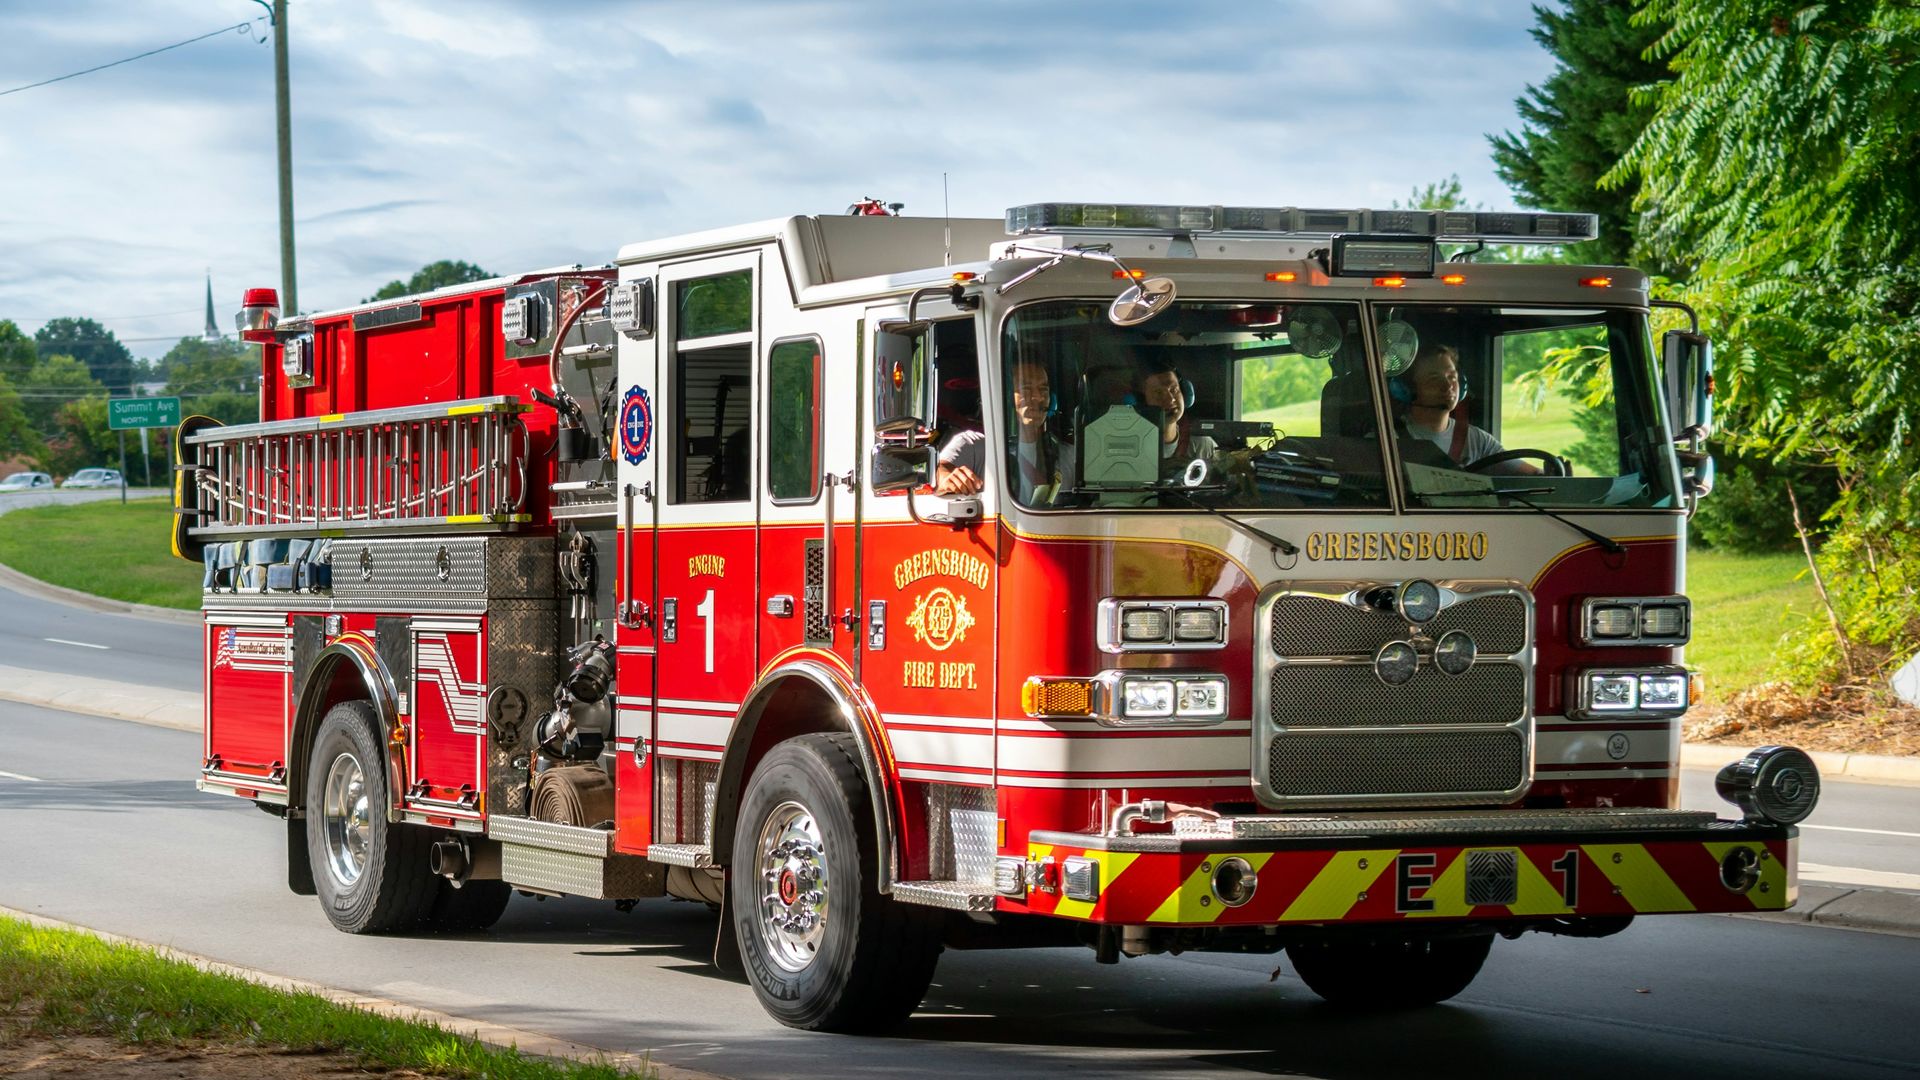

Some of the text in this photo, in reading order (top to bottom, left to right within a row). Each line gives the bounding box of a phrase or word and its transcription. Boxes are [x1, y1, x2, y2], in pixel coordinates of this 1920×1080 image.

[115, 401, 175, 413] Summit Ave
[121, 416, 148, 424] NORTH
[632, 408, 640, 442] 1
[1306, 531, 1489, 561] GREENSBORO
[689, 554, 725, 578] ENGINE
[894, 548, 989, 590] GREENSBORO
[697, 589, 715, 673] 1
[903, 661, 977, 690] FIRE DEPT.
[1395, 849, 1579, 914] E 1
